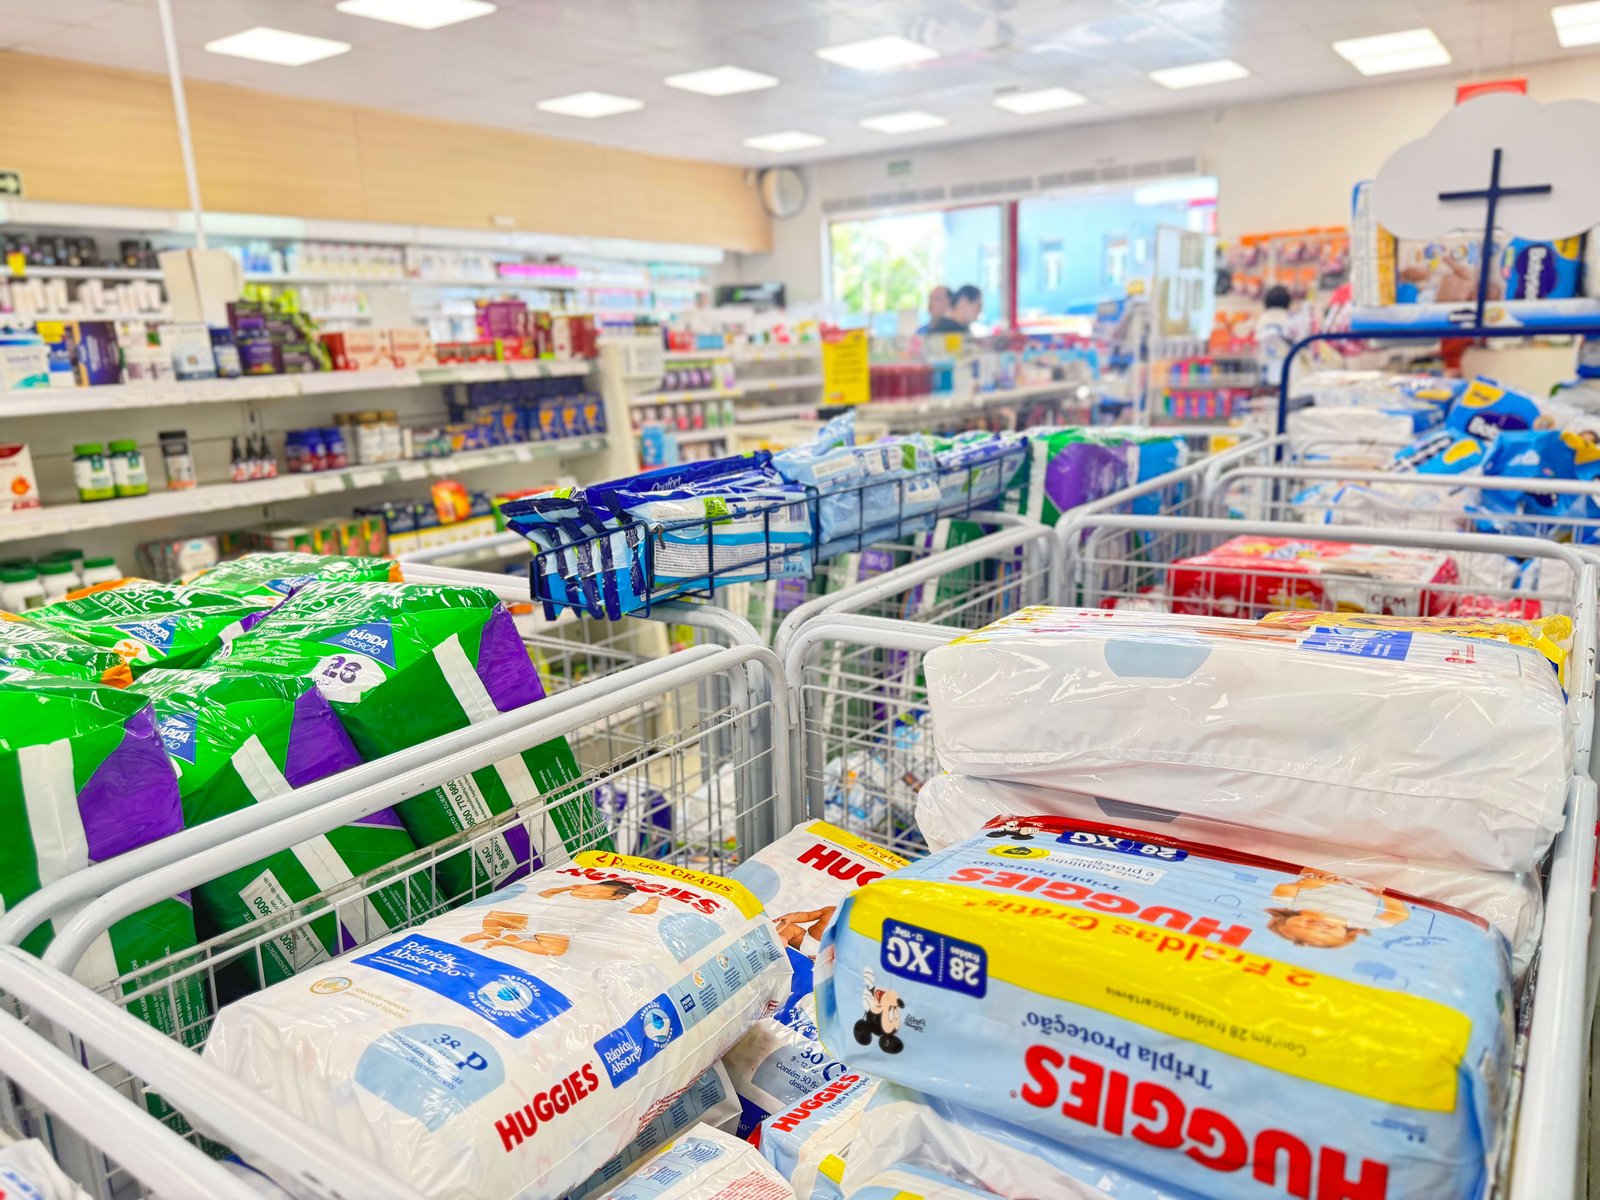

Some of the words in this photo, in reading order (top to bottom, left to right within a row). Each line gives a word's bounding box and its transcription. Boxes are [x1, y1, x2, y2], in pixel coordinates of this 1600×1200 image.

[340, 637, 381, 656] ABSORÇÃO
[346, 629, 389, 649] RÁPIDA
[454, 794, 468, 811] 770
[1070, 831, 1123, 850] XG
[1140, 844, 1179, 859] 28
[481, 846, 495, 864] SAC
[671, 867, 733, 893] GRÁTIS
[975, 860, 1060, 879] Proteção
[1061, 872, 1122, 892] Tripla
[947, 867, 1253, 947] HUGGIES
[401, 941, 457, 964] Rápida
[887, 936, 935, 976] XG
[949, 946, 981, 964] fraldas
[1112, 922, 1275, 978] Fraldas
[385, 948, 461, 978] Absorção
[949, 957, 981, 987] 28
[1286, 968, 1317, 988] 2
[1104, 986, 1181, 1015] descartáveis
[905, 1013, 927, 1028] baby
[1183, 1009, 1229, 1031] fraldas
[1229, 1024, 1248, 1039] 28
[1022, 1011, 1131, 1060] Proteção
[1251, 1029, 1307, 1058] Contém
[455, 1051, 488, 1071] P
[603, 1040, 634, 1064] Rápida
[801, 1047, 824, 1065] 30
[776, 1062, 801, 1081] Contém
[800, 1076, 812, 1085] 30
[1137, 1046, 1214, 1091] Tripla
[494, 1063, 599, 1153] HUGGIES
[771, 1074, 860, 1133] HUGGIES
[1021, 1044, 1389, 1200] HUGGIES
